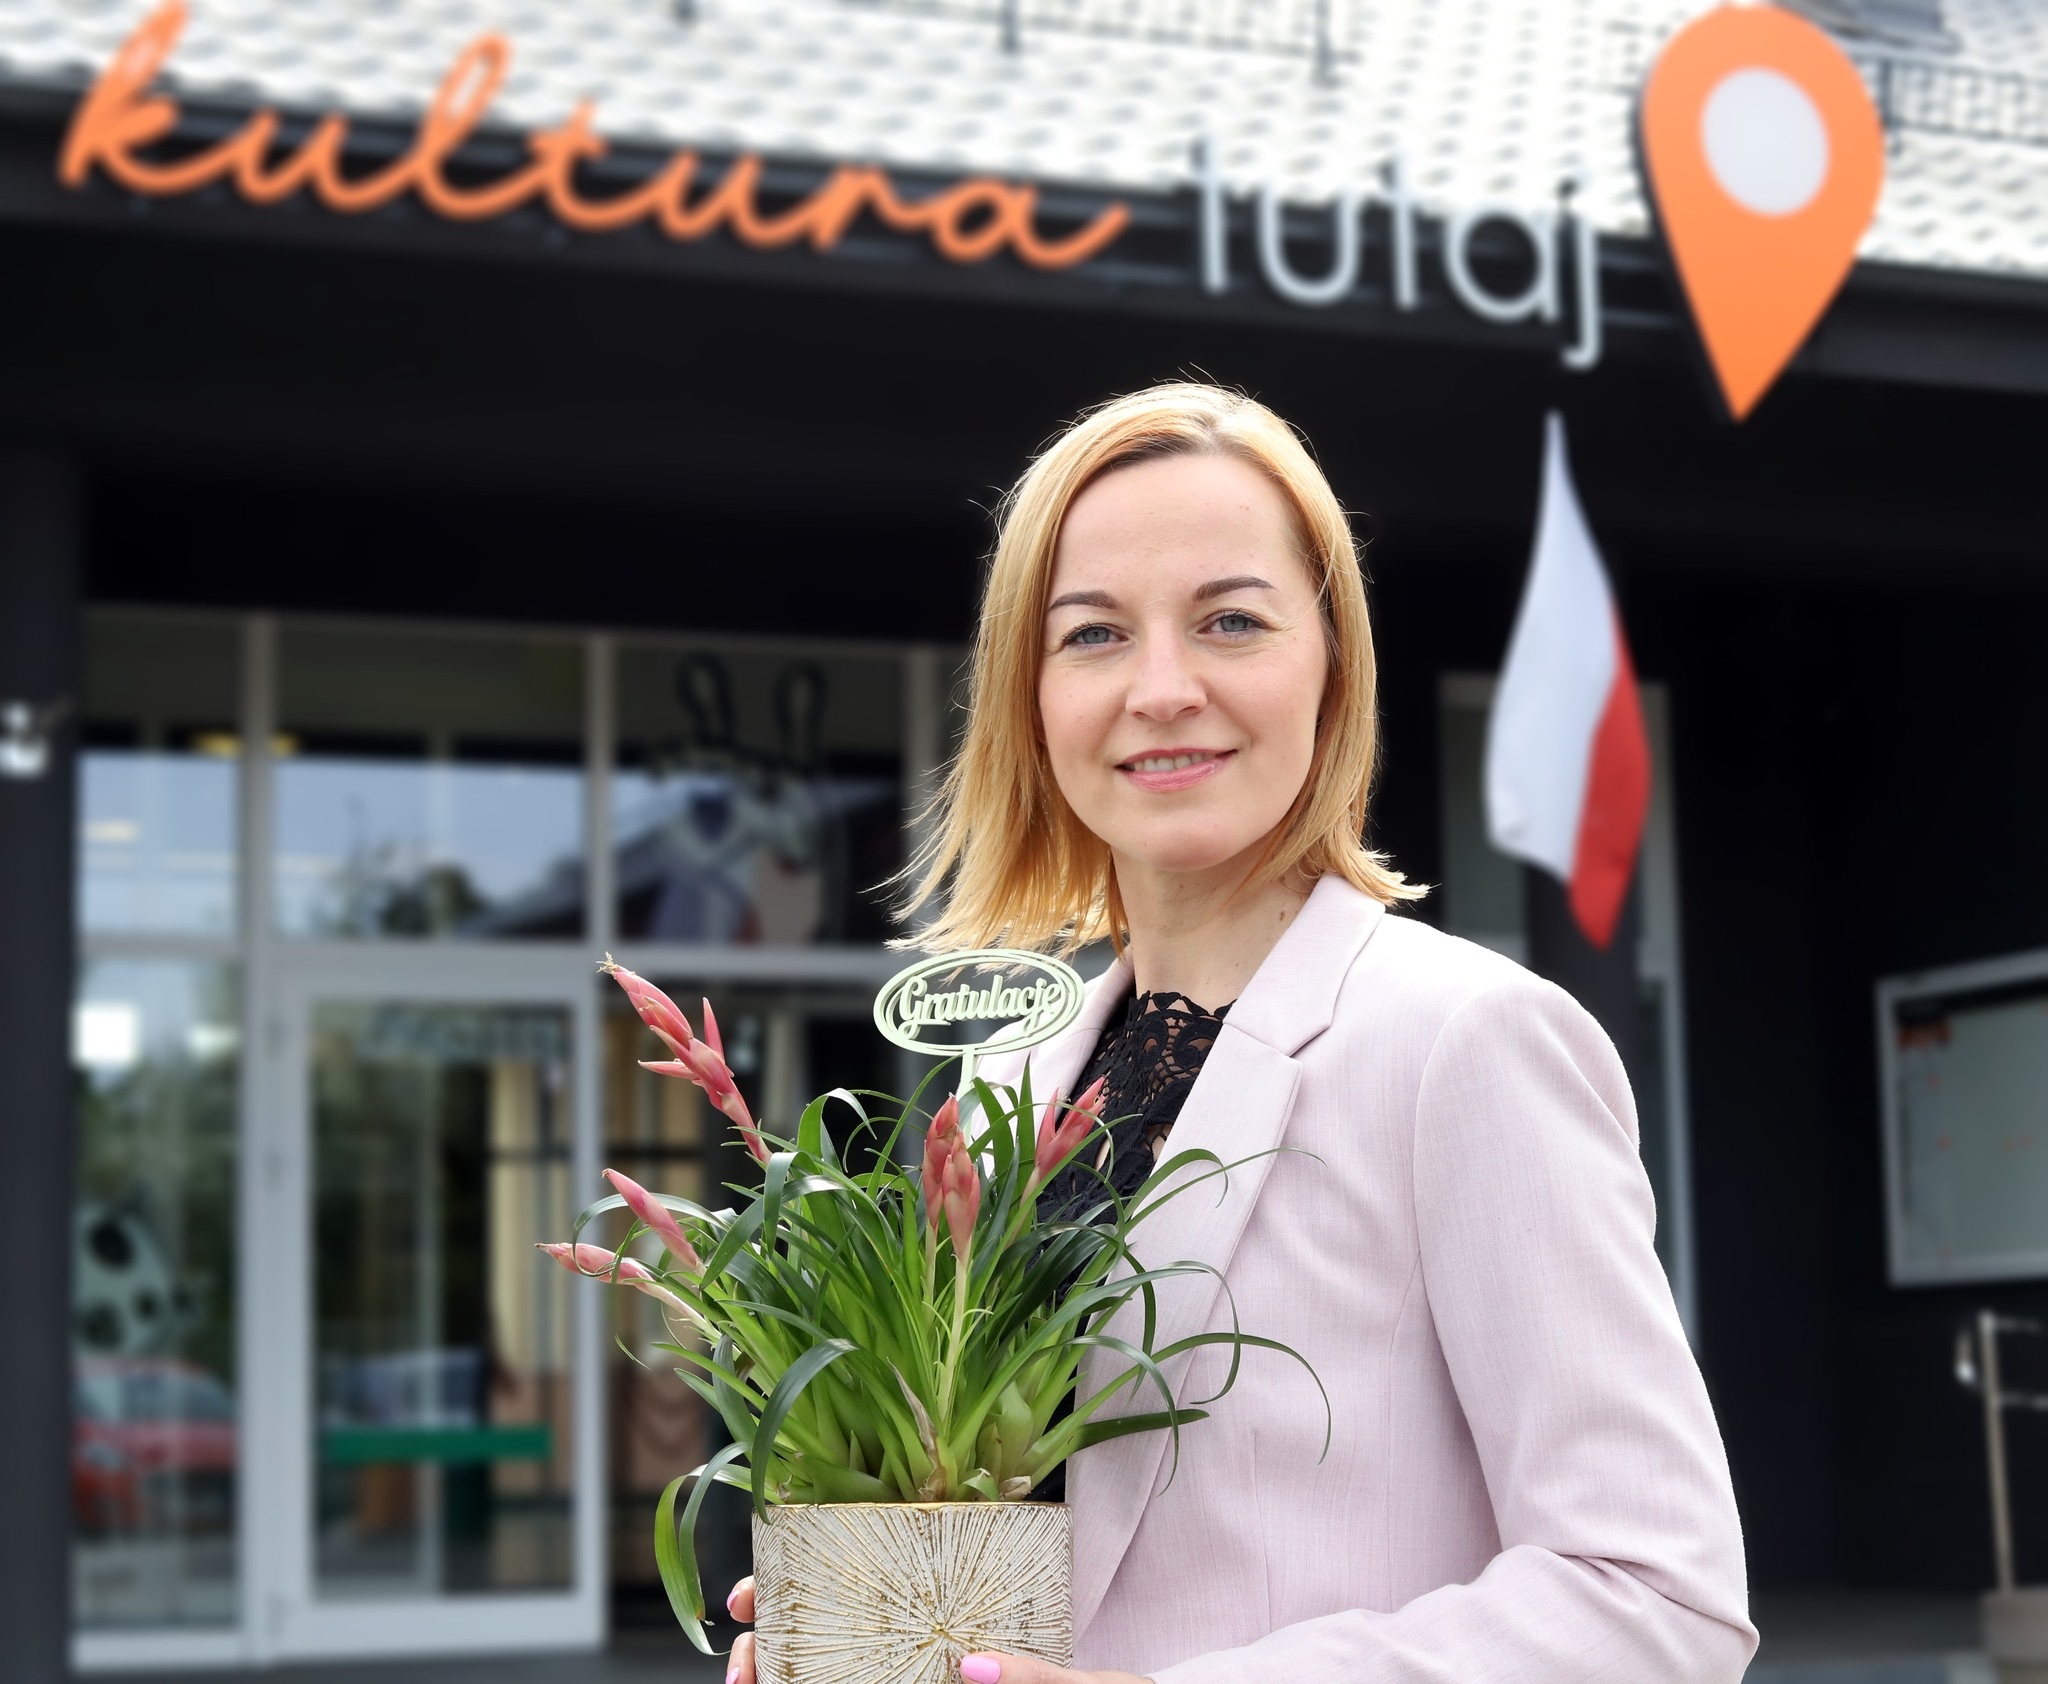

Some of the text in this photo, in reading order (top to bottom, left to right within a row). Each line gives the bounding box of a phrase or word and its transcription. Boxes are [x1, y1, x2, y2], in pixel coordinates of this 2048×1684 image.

[58, 0, 1604, 371] kultura tutaj
[898, 974, 1062, 1040] Gratulacje
